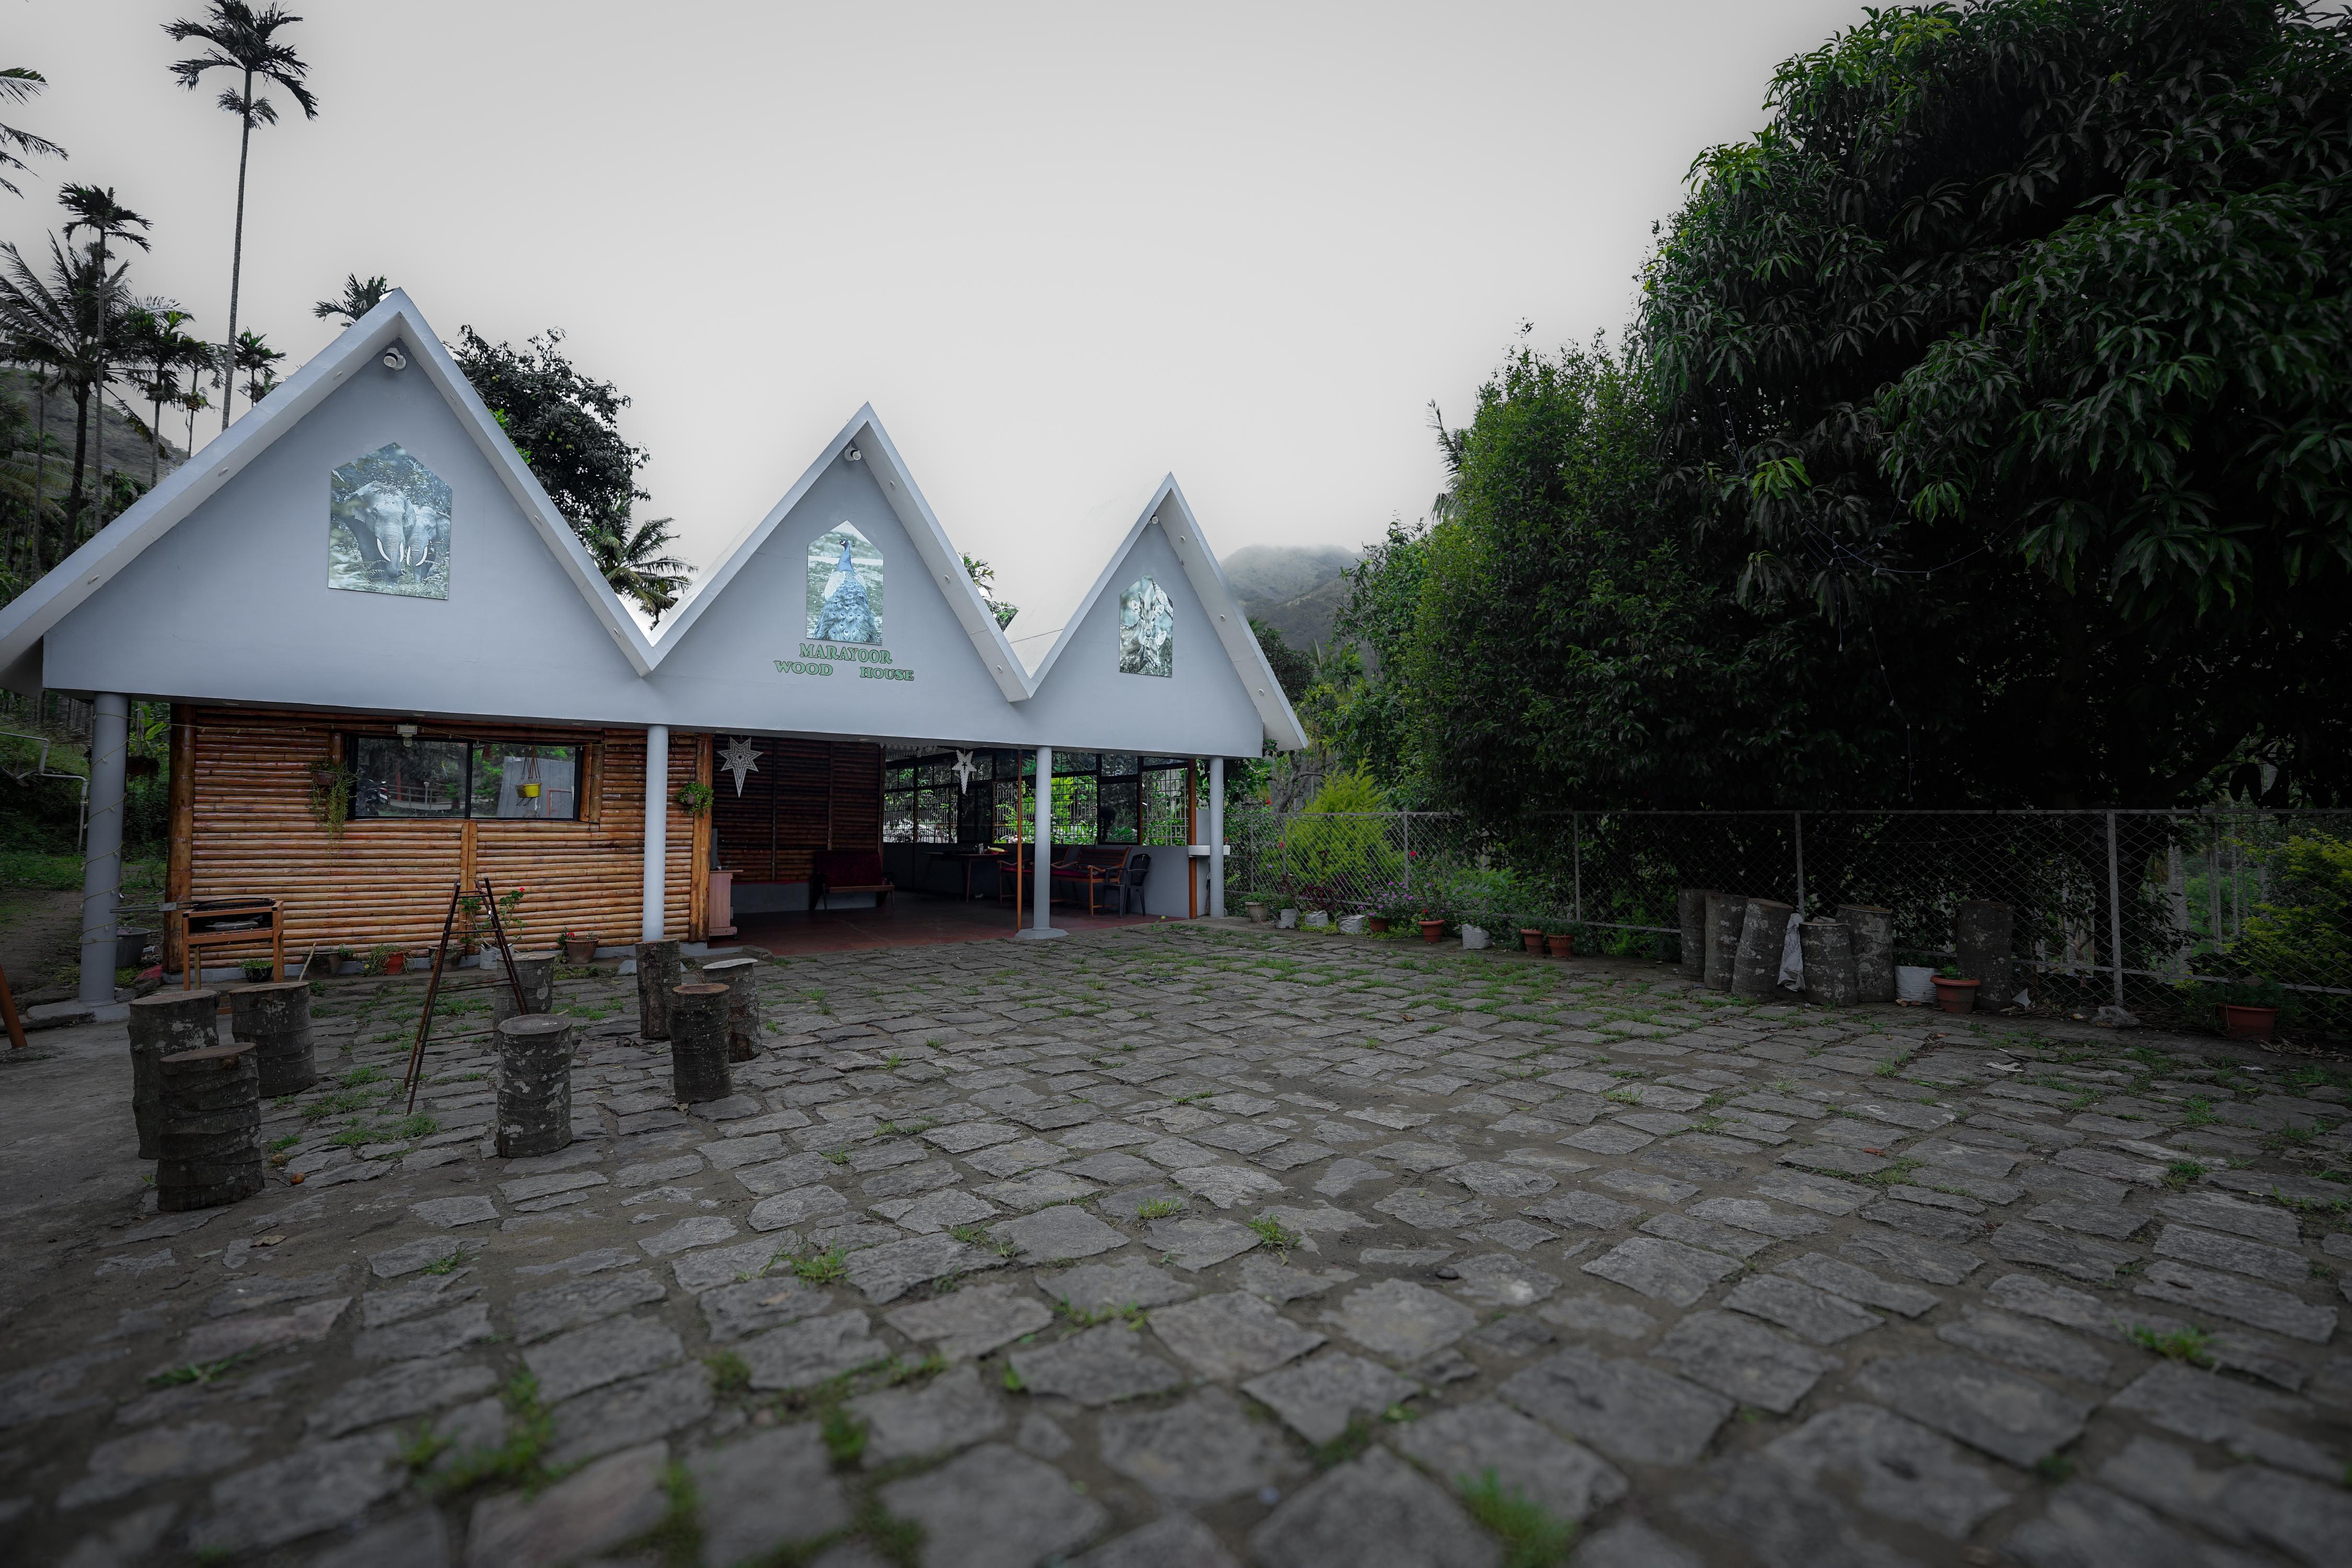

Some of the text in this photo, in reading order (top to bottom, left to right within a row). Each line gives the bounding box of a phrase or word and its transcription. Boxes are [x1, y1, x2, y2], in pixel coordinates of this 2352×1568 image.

[799, 643, 893, 664] MARAYOOR
[774, 661, 914, 681] WOOD HOUSE
